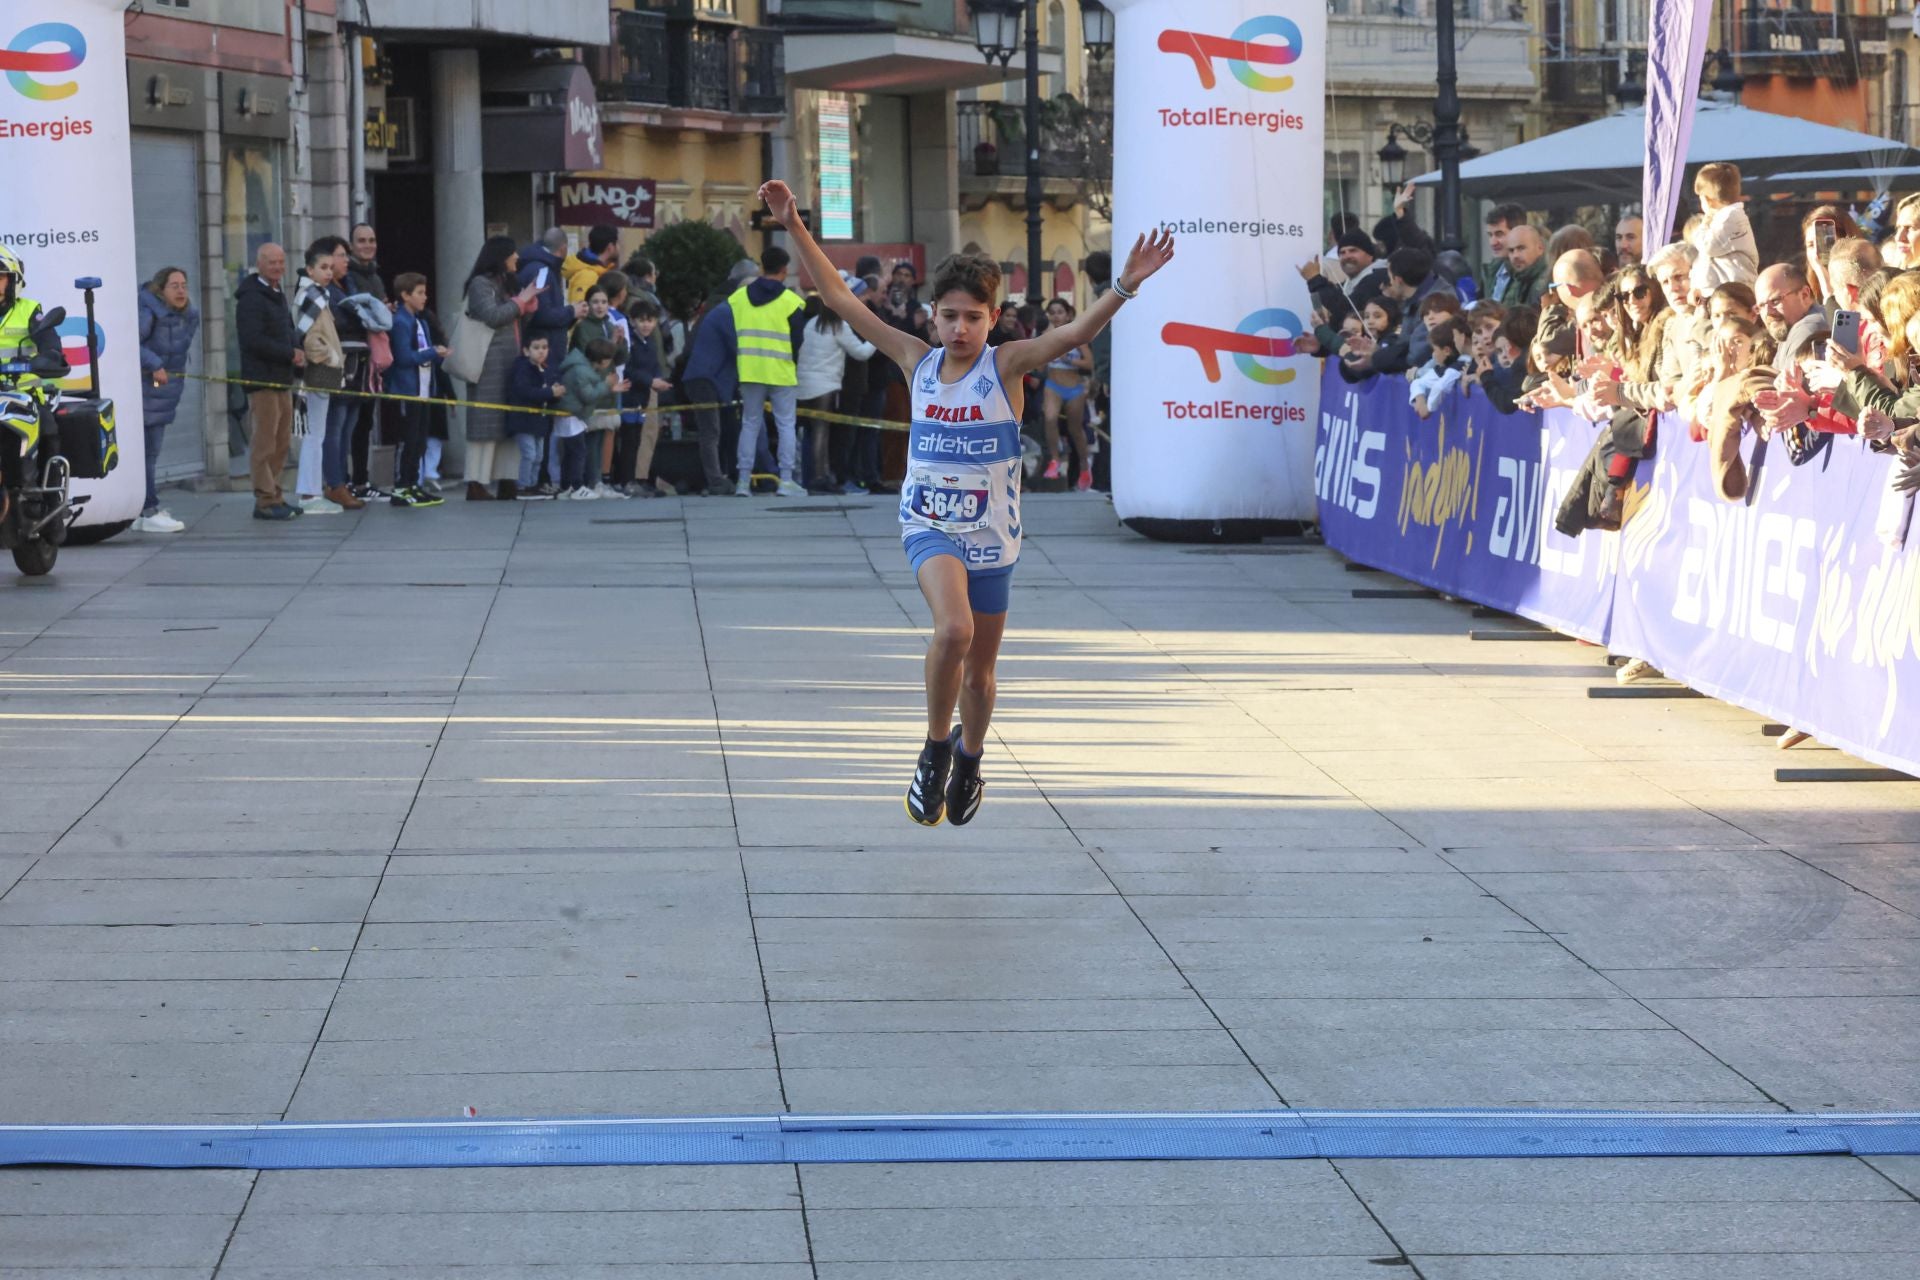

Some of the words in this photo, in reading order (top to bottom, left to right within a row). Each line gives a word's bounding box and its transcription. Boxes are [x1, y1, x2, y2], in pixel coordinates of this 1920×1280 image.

[1158, 108, 1303, 132] TotalEnergies
[0, 229, 98, 248] nergies.es
[1160, 218, 1303, 237] totalenergies.es
[1163, 401, 1305, 425] TotalEnergies
[918, 432, 998, 455] atlética
[921, 490, 978, 519] 3649
